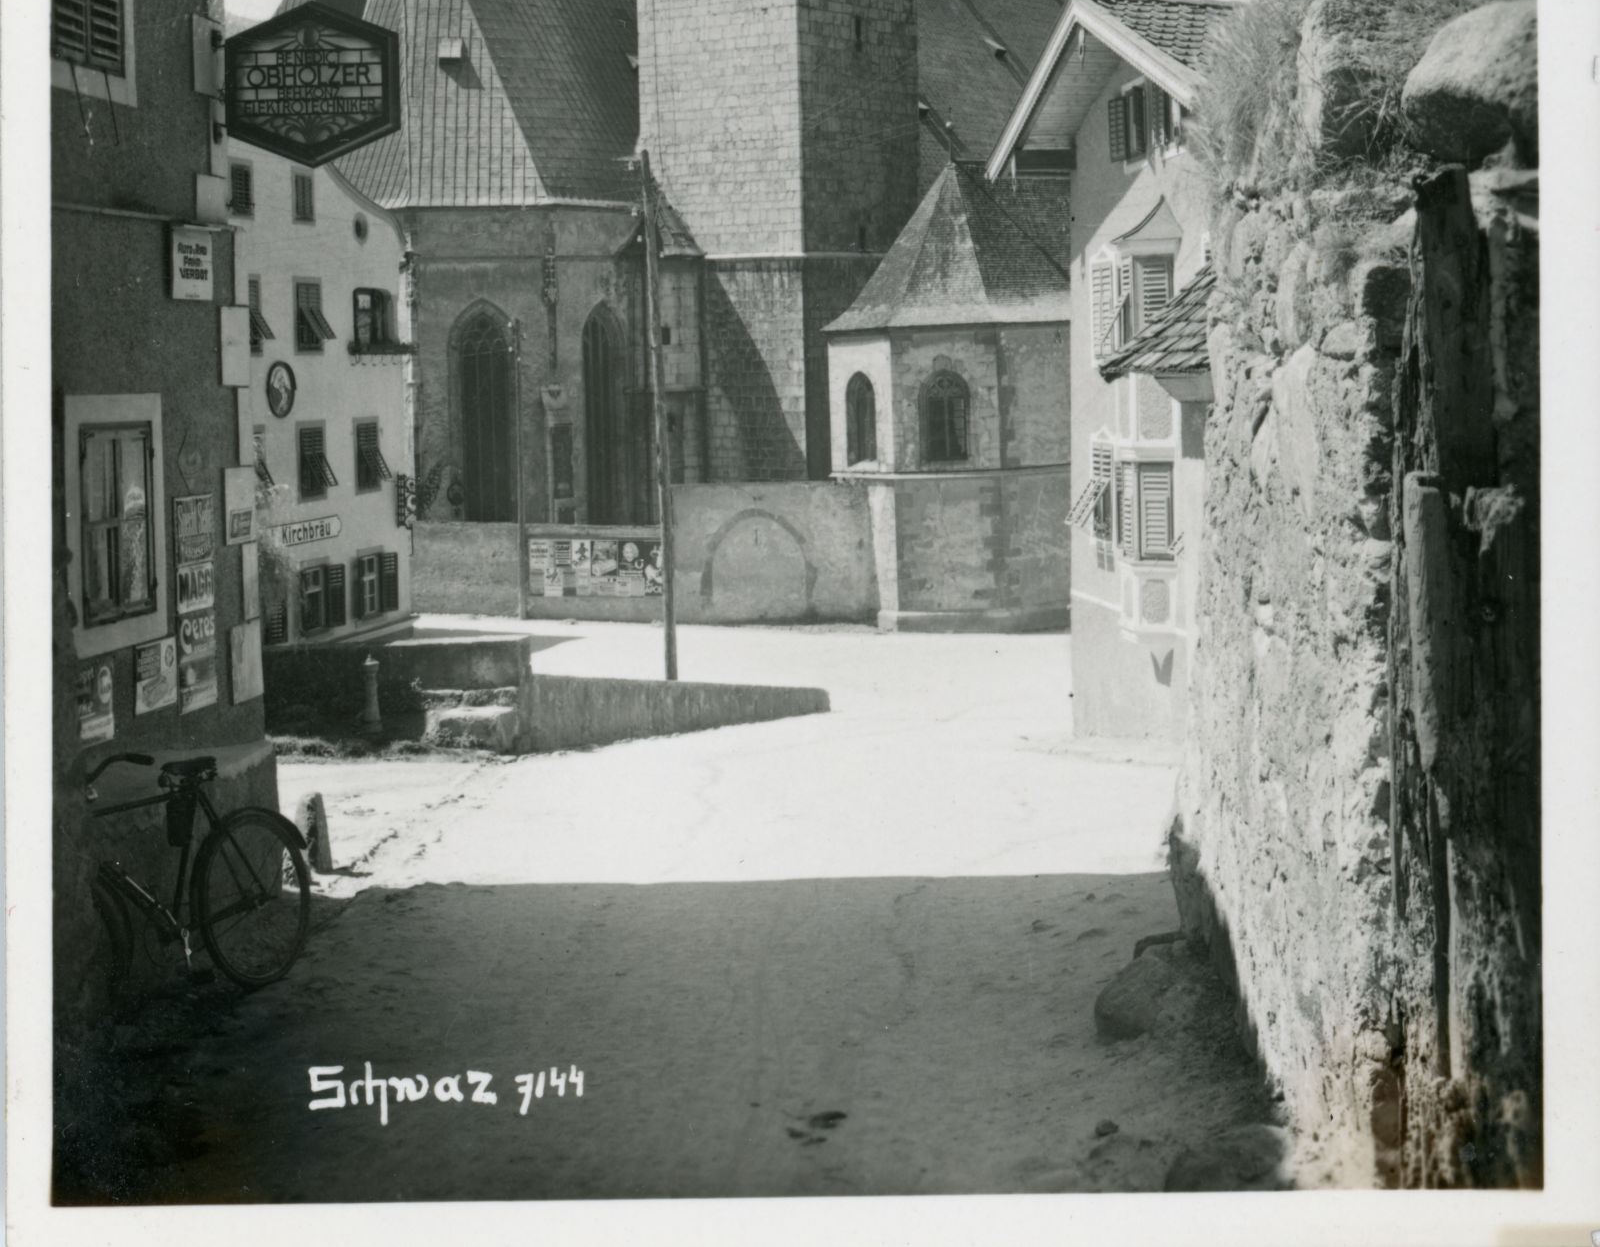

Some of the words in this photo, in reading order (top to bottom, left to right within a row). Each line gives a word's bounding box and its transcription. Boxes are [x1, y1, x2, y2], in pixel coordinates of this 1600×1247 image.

[246, 64, 371, 87] OBHOLZER
[243, 98, 377, 115] ELEKTROTECHNIKER
[281, 520, 331, 545] Kirchbräu
[178, 567, 214, 604] MAGGI
[180, 615, 215, 654] Ceres
